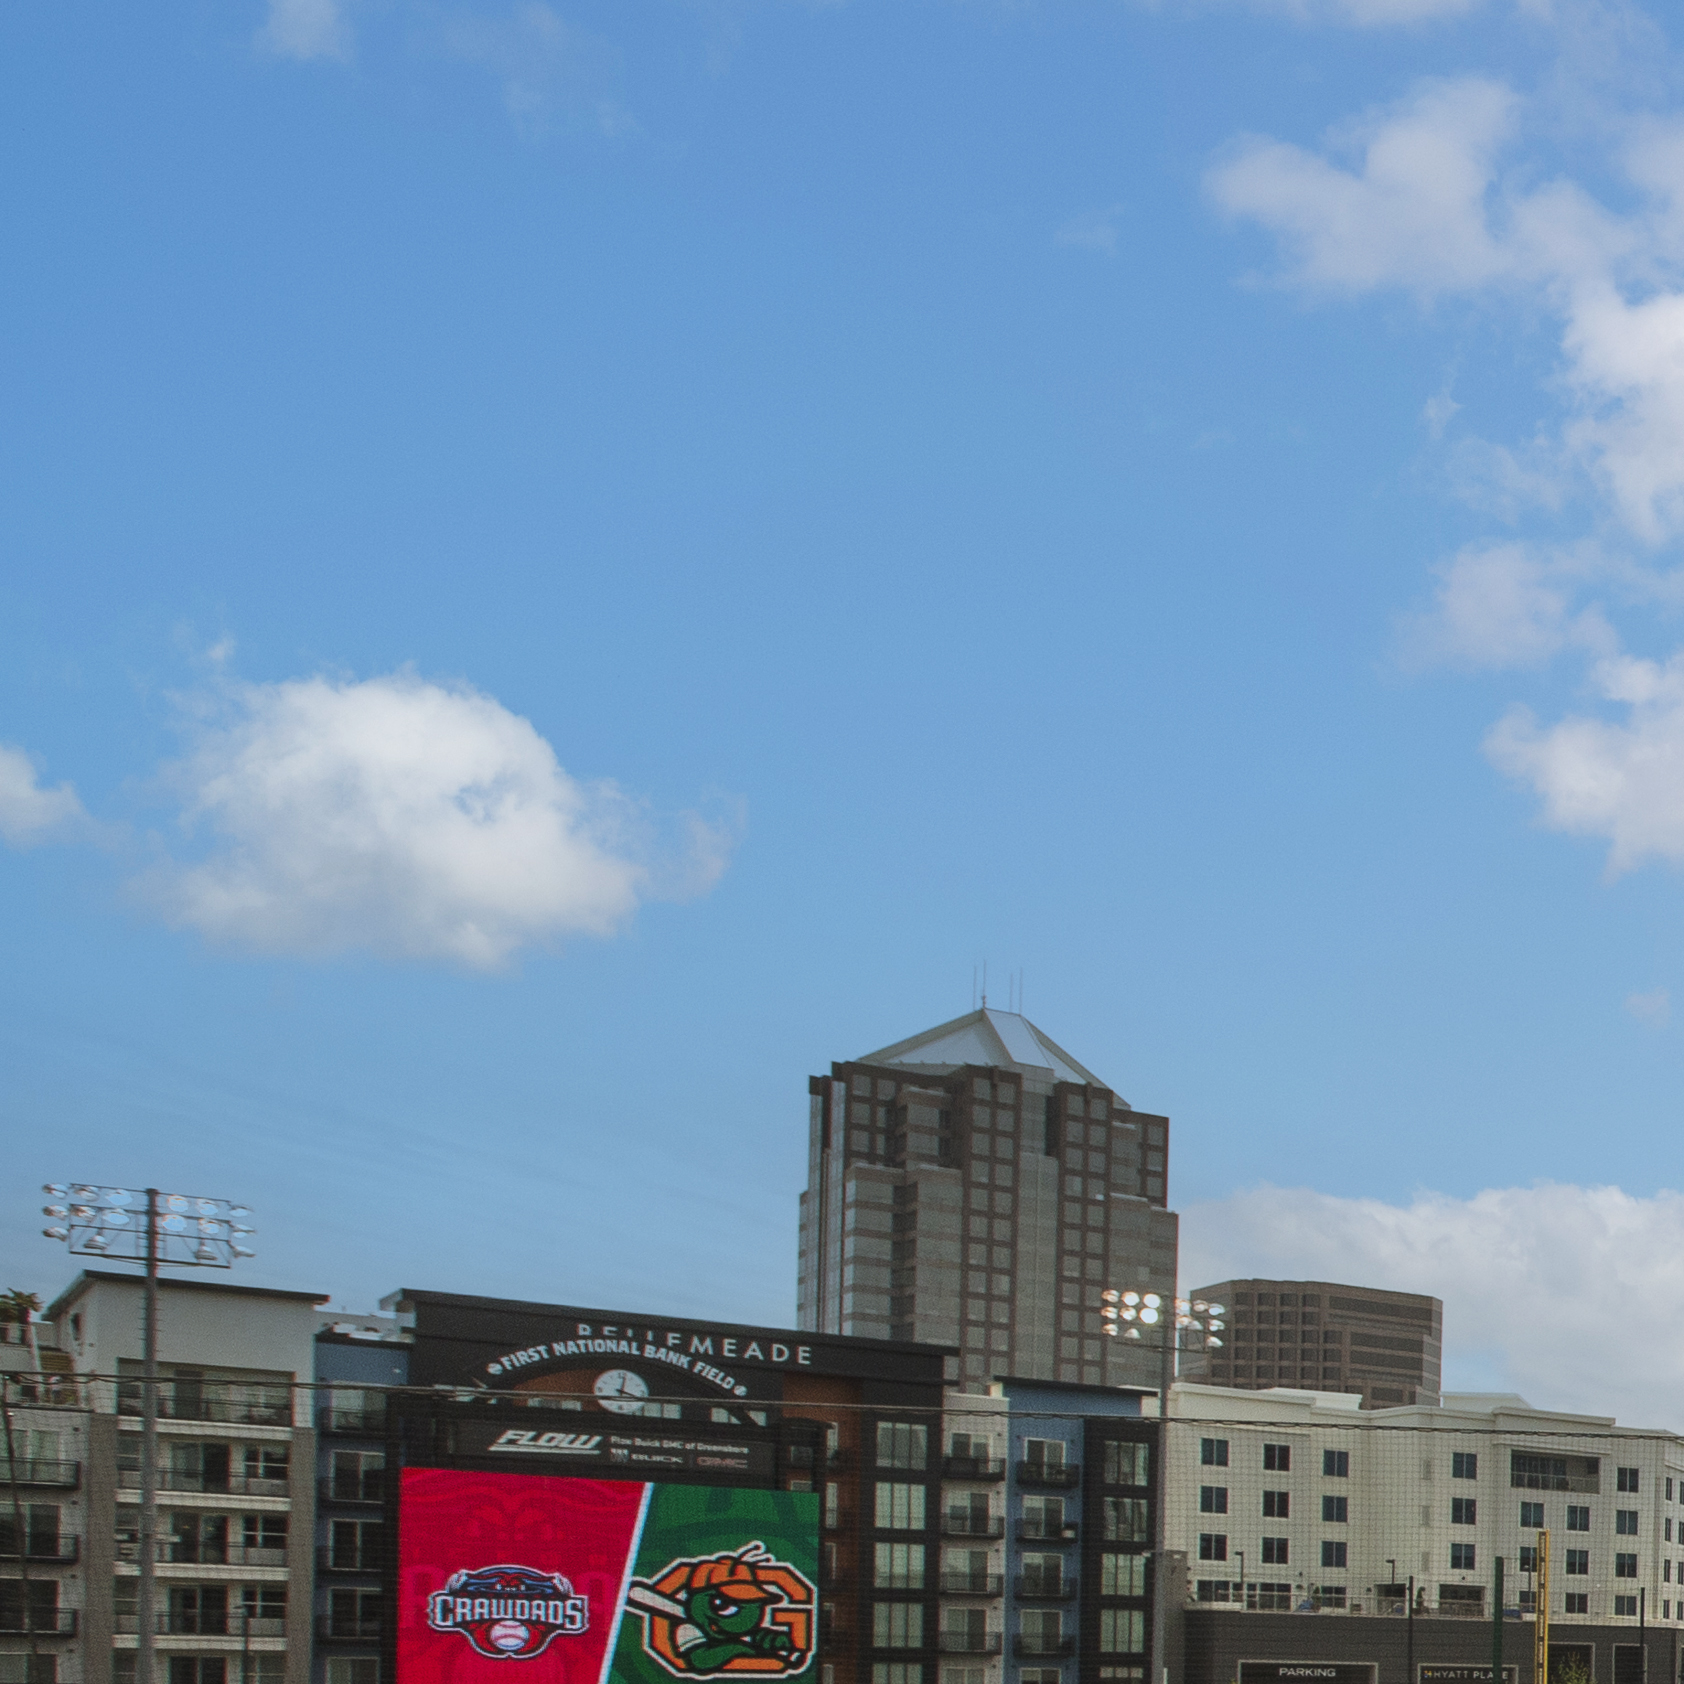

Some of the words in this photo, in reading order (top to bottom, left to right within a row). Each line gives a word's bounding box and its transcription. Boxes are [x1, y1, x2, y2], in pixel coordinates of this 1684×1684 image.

[500, 1346, 550, 1371] FIRST
[552, 1339, 641, 1356] NATIONAL
[643, 1343, 691, 1369] BANK
[693, 1361, 735, 1390] FIELD
[498, 1429, 602, 1449] FLOW
[432, 1595, 584, 1630] CRAWDADS
[1279, 1668, 1336, 1678] PARKING
[1433, 1670, 1468, 1679] HYATT
[1473, 1671, 1508, 1680] PLAE
